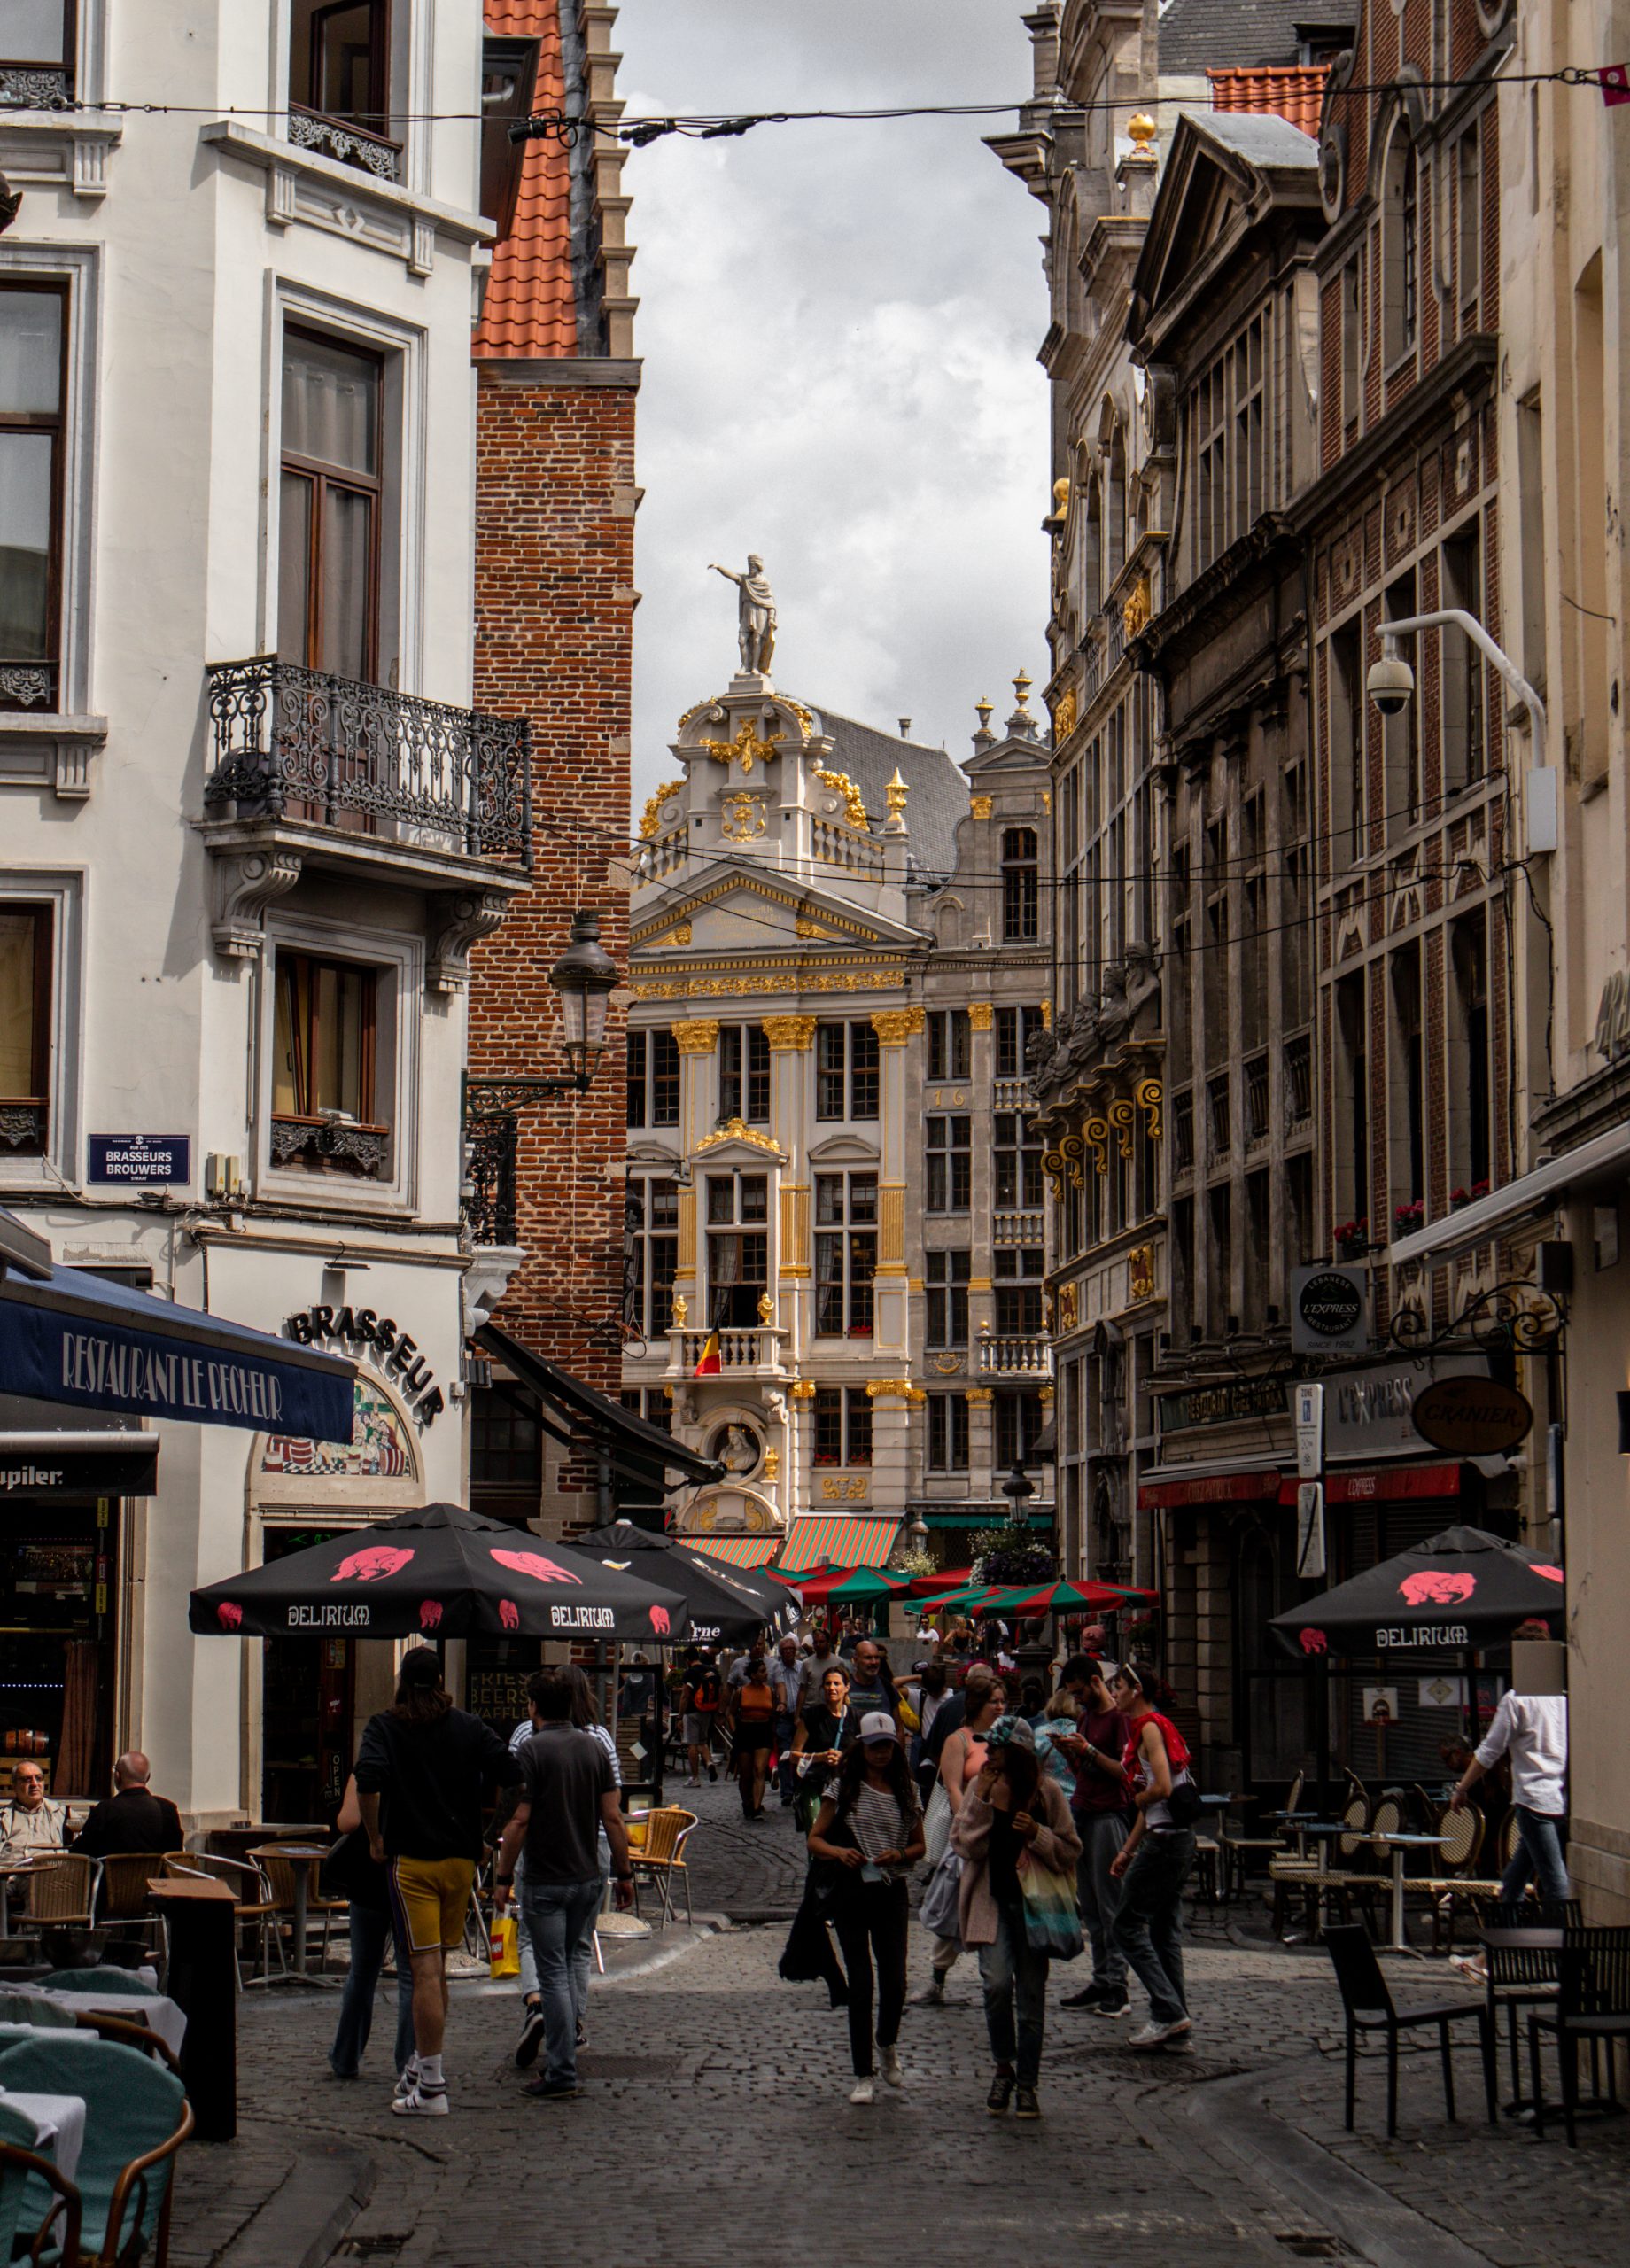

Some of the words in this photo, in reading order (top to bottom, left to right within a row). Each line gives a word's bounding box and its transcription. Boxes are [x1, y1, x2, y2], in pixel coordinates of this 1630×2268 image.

[105, 1151, 172, 1162] BRASSEURS
[106, 1164, 172, 1175] BROUWERS
[1308, 1276, 1352, 1291] LEBANESE
[1303, 1303, 1358, 1314] L'EXPRESS
[1306, 1315, 1354, 1332] RESTAURANT
[1306, 1340, 1331, 1349] SINCE
[287, 1304, 444, 1426] BRASSEUR
[62, 1332, 179, 1404] RESTAURANT
[182, 1356, 207, 1409] LE
[207, 1362, 283, 1422] PECHEUR
[1337, 1377, 1414, 1425] L'EXPRESS
[1425, 1403, 1519, 1427] GRANIER
[287, 1604, 370, 1626] DELIRIUM
[550, 1605, 616, 1628] DELIRIUM
[1376, 1624, 1469, 1649] DELIRIUM
[470, 1687, 529, 1705] BEERS
[332, 1754, 342, 1798] OPEN
